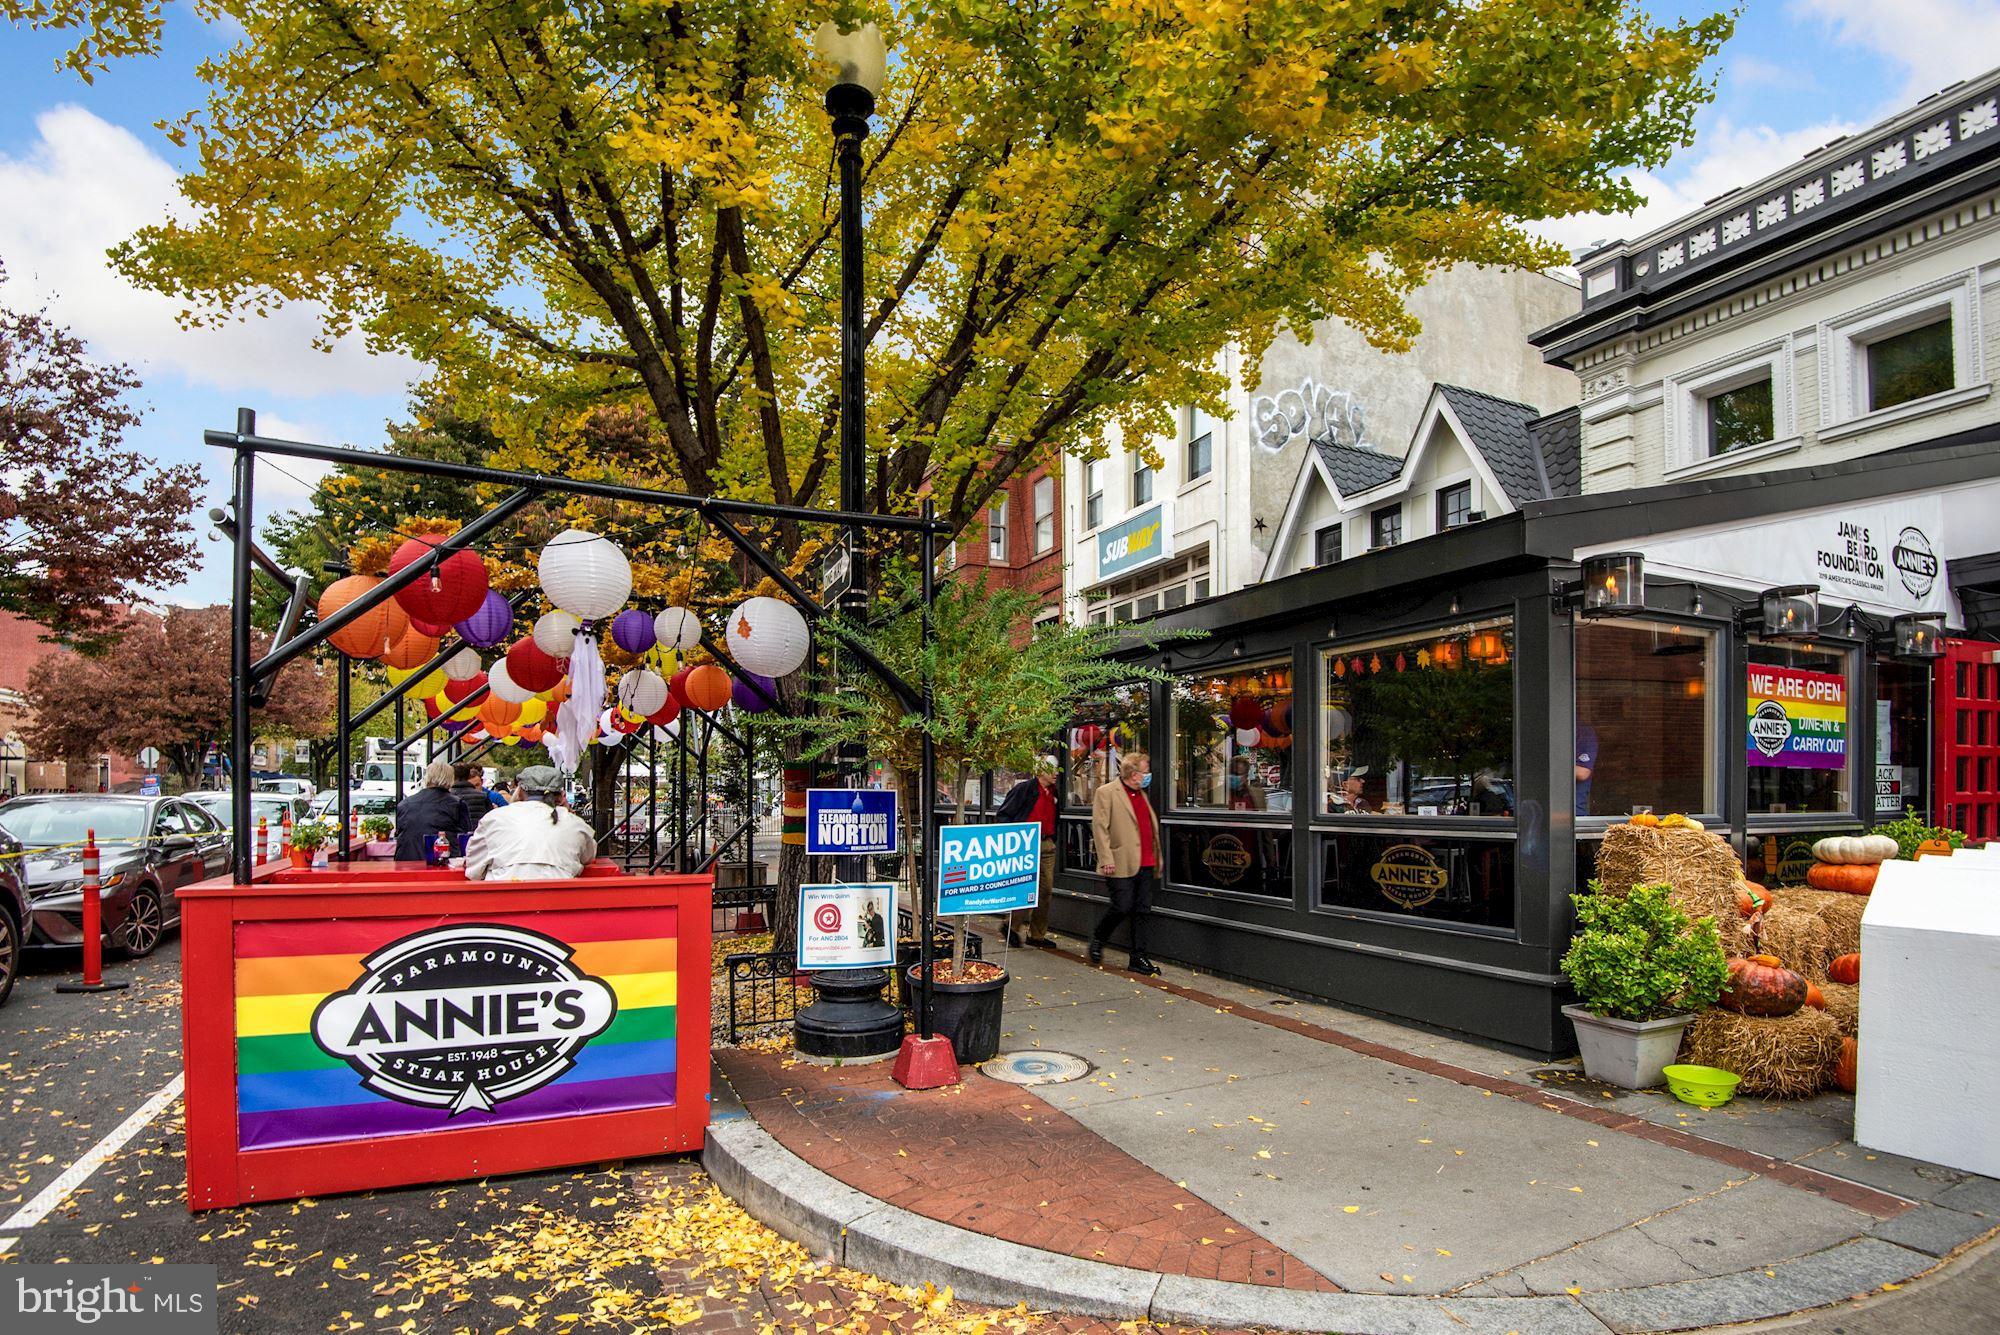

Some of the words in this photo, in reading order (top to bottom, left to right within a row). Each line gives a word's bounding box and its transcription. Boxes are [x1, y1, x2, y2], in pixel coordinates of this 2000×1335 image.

[1838, 521, 1869, 543] JAMES
[1102, 521, 1160, 565] SUBWAY
[1847, 540, 1878, 561] BEARD
[1817, 550, 1884, 579] FOUNDATION
[1898, 549, 1936, 575] ANNIE'S
[1751, 673, 1773, 695] WE
[1777, 677, 1803, 699] ARE
[1807, 680, 1841, 702] OPEN
[1753, 720, 1787, 736] ANNIE'S
[1798, 717, 1832, 732] DINE-IN
[1833, 720, 1840, 732] &
[1793, 736, 1825, 752] CARRY
[1826, 739, 1845, 753] OUT
[1876, 769, 1894, 780] ACK
[1876, 782, 1892, 794] VES
[1876, 796, 1900, 807] ATTER
[818, 813, 858, 824] ELEANOR
[860, 813, 887, 824] HOLMES
[818, 824, 887, 845] NORTON
[944, 828, 1036, 864] RANDY
[969, 854, 1034, 880] DOWNS
[1378, 866, 1440, 885] ANNIE'S
[944, 888, 958, 896] FOR
[959, 885, 979, 894] WARD
[985, 875, 1032, 890] COUNCILMEMBER
[391, 950, 549, 987] PARAMOUNT
[346, 989, 586, 1047] ANNIE'S
[393, 1058, 465, 1082] STEAK
[477, 1045, 549, 1081] HOUSE
[448, 1051, 469, 1062] EST.
[471, 1048, 498, 1061] 1948
